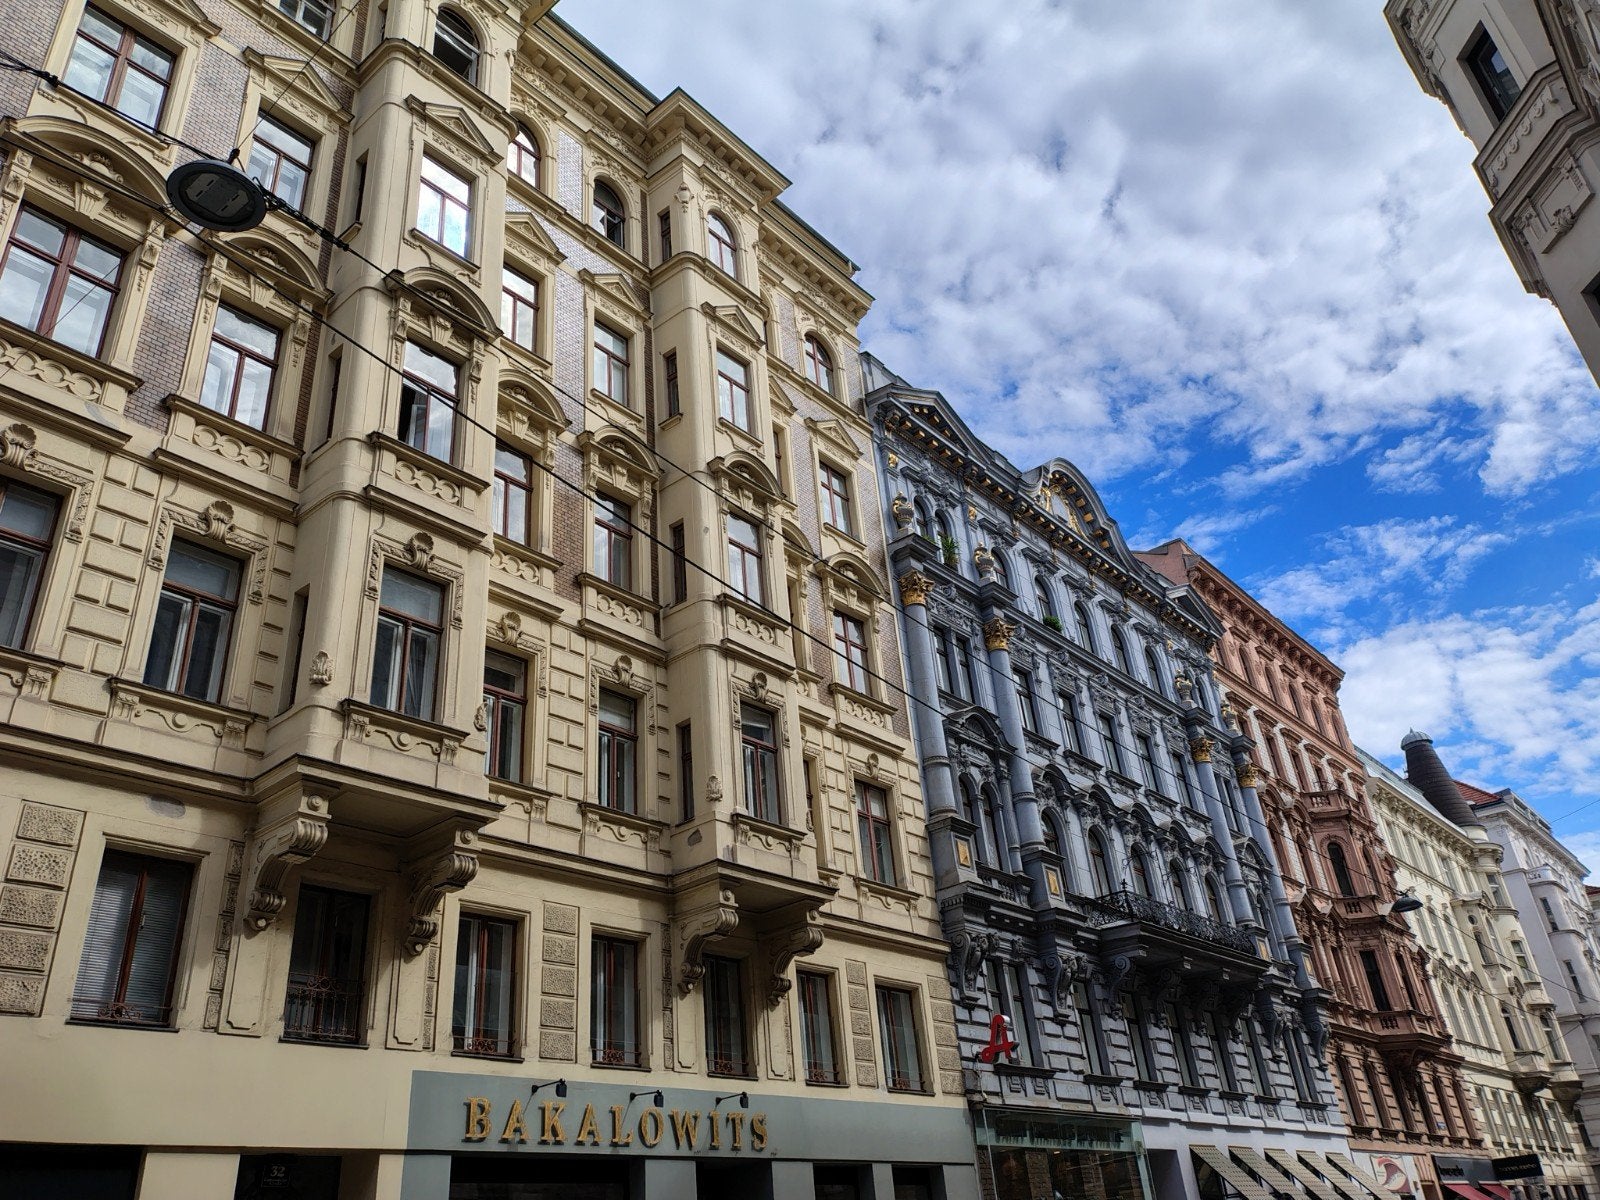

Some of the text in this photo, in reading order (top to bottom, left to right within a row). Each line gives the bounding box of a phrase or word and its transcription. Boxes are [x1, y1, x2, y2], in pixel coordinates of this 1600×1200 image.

[981, 1014, 1015, 1064] A
[463, 1096, 769, 1152] BAKALOWITS
[270, 1165, 286, 1177] 32
